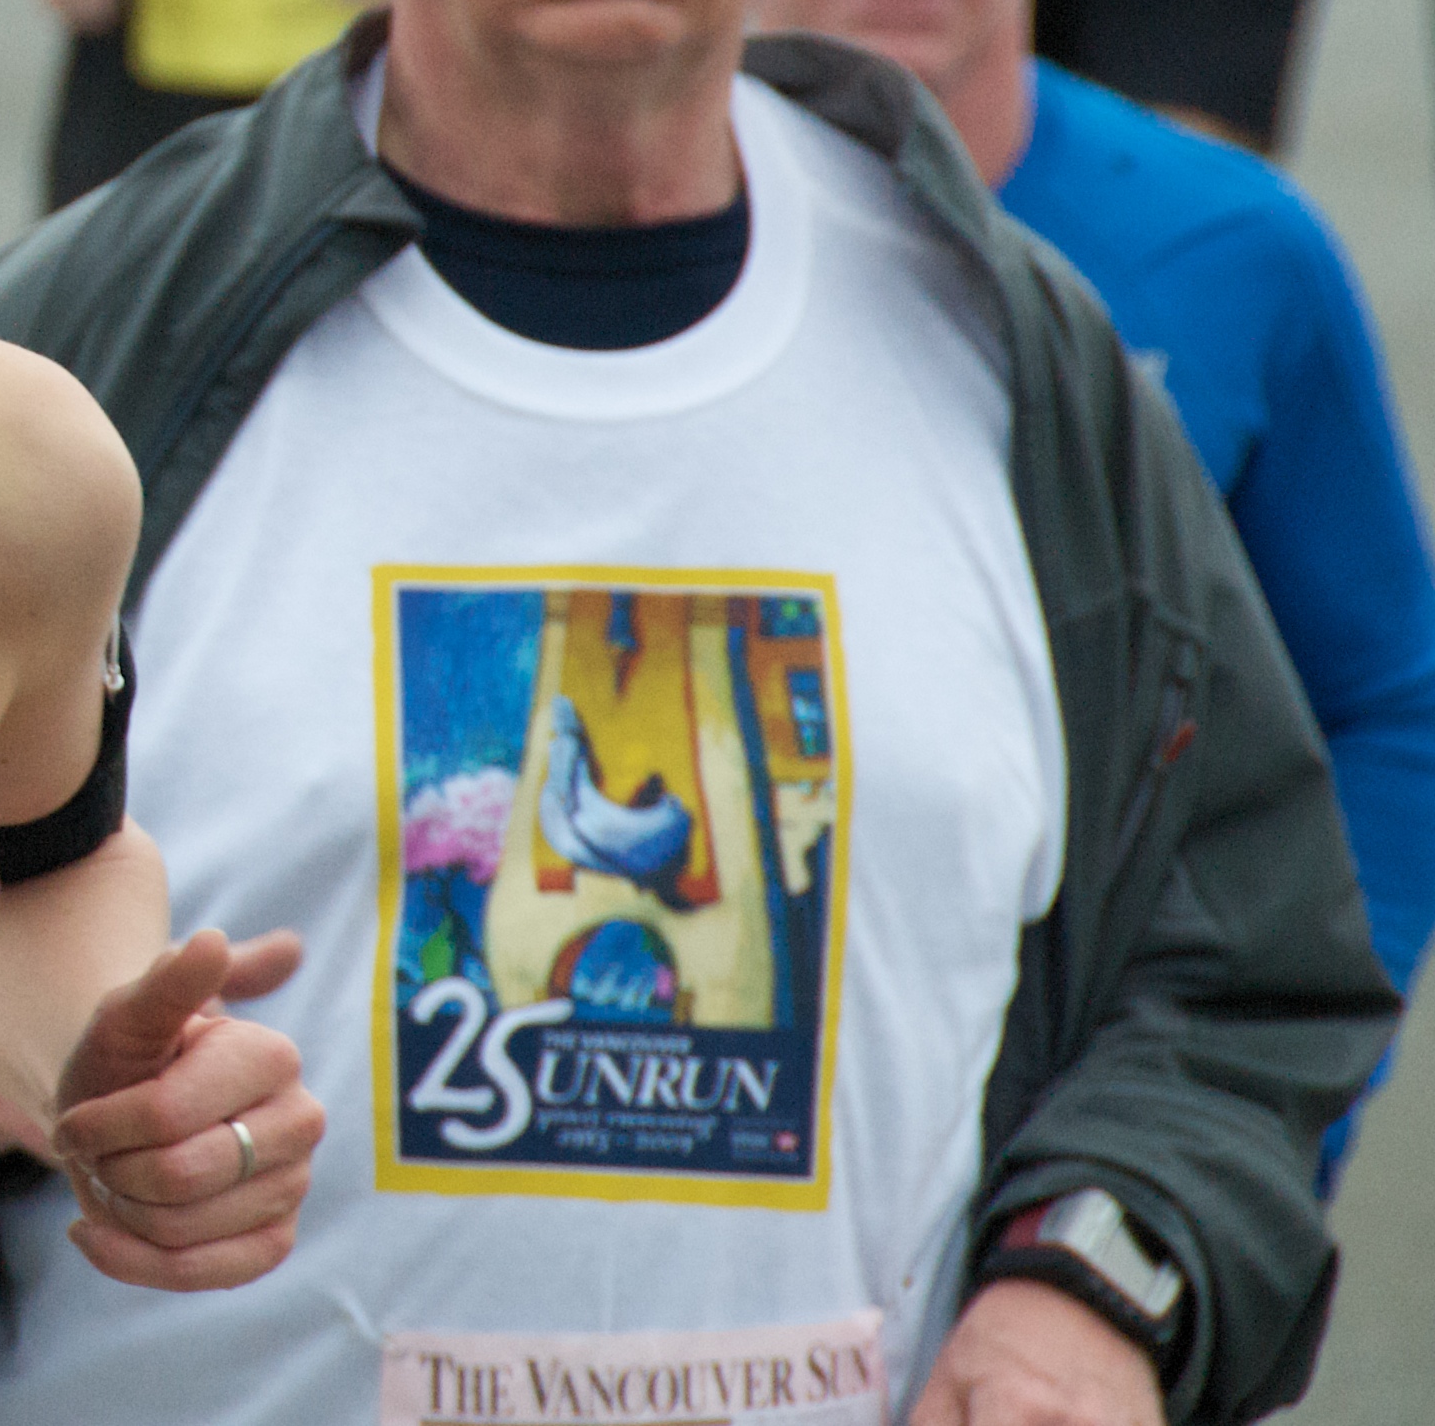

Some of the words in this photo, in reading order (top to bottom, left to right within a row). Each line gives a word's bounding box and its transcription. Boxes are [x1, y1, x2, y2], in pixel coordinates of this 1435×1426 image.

[411, 976, 574, 1150] 25
[419, 1351, 514, 1417] THE
[527, 1346, 795, 1417] VANCOUVER
